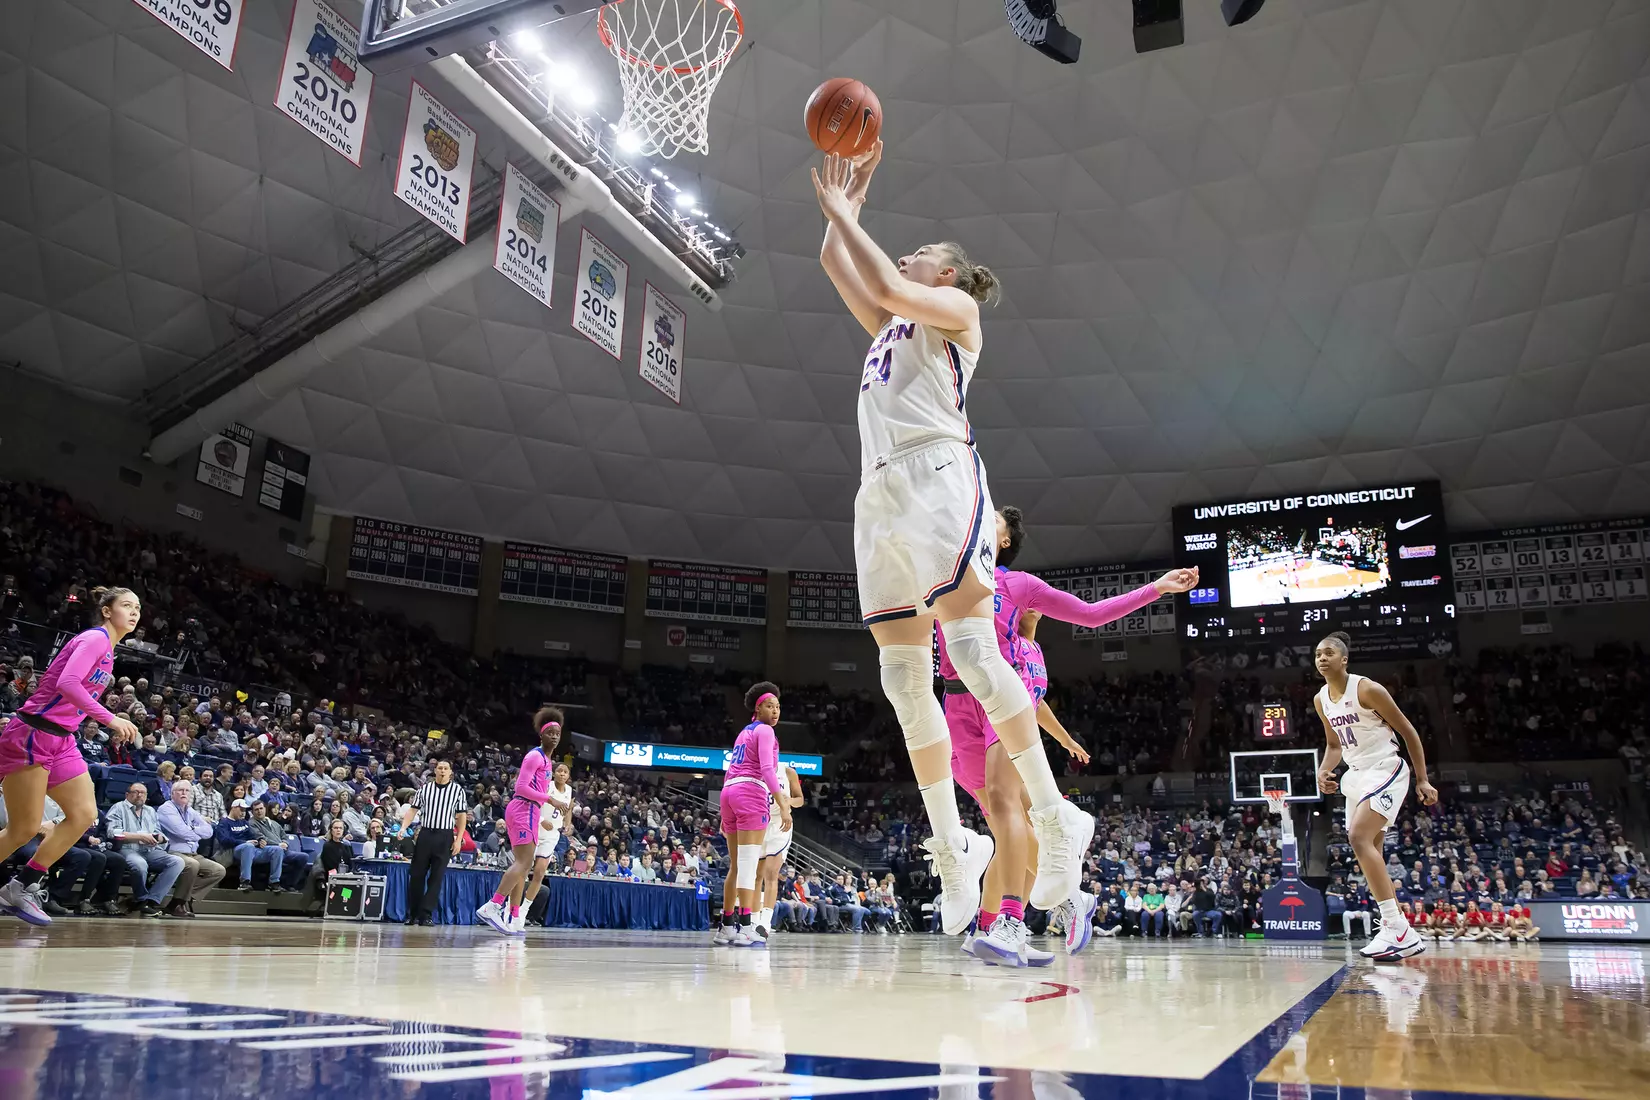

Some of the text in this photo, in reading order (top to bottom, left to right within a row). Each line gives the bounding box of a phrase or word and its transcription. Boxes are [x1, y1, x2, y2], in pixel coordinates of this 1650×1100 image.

[143, 0, 222, 57] HAMPIONS
[316, 12, 358, 52] Basketball
[293, 62, 357, 125] 2010
[418, 87, 442, 111] UConn
[294, 90, 350, 139] NATIONAL
[427, 106, 461, 139] Basketball
[286, 101, 353, 155] CHAMPIONS
[409, 154, 461, 206] 2013
[410, 179, 456, 220] NATIONAL
[404, 189, 458, 234] CHAMPIONS
[505, 228, 548, 274] 2014
[506, 251, 544, 286] NATIONAL
[502, 262, 546, 299] CHAMPIONS
[581, 289, 617, 329] 2015
[582, 311, 615, 341] NATIONAL
[578, 320, 617, 354] CHAMPIONS
[646, 340, 678, 377] 2016
[646, 360, 675, 387] NATIONAL
[643, 369, 677, 399] CHAMPIONS
[1194, 486, 1416, 520] UNIVERSITY OF CONNECTICUT
[356, 519, 480, 545] BIG EAST CONFERENCE
[1184, 532, 1218, 543] WELLS
[1186, 541, 1218, 552] FARGO
[1582, 547, 1605, 561] 42
[1456, 557, 1476, 571] 52
[1518, 552, 1539, 566] 00
[1551, 549, 1570, 563] 13
[795, 572, 822, 581] NCAA
[1045, 568, 1081, 576] HUSKIES
[1097, 564, 1126, 572] HONOR
[1400, 578, 1435, 587] TRAVELERS
[1590, 582, 1606, 597] 13
[1099, 587, 1118, 600] 44
[1465, 592, 1477, 605] 15
[1495, 590, 1508, 604] 22
[1303, 608, 1328, 622] 2:37
[1444, 604, 1455, 618] 9
[1128, 617, 1145, 630] 22
[181, 683, 195, 692] SEC
[1264, 707, 1287, 719] 2:37
[1329, 712, 1361, 728] CONN
[1262, 719, 1286, 736] 21
[681, 753, 709, 764] Company
[731, 743, 747, 765] 20
[789, 761, 817, 771] Company
[1572, 781, 1590, 791] 116
[551, 807, 559, 819] 5
[1561, 904, 1636, 920] UCONN
[1263, 920, 1322, 931] TRAVELERS
